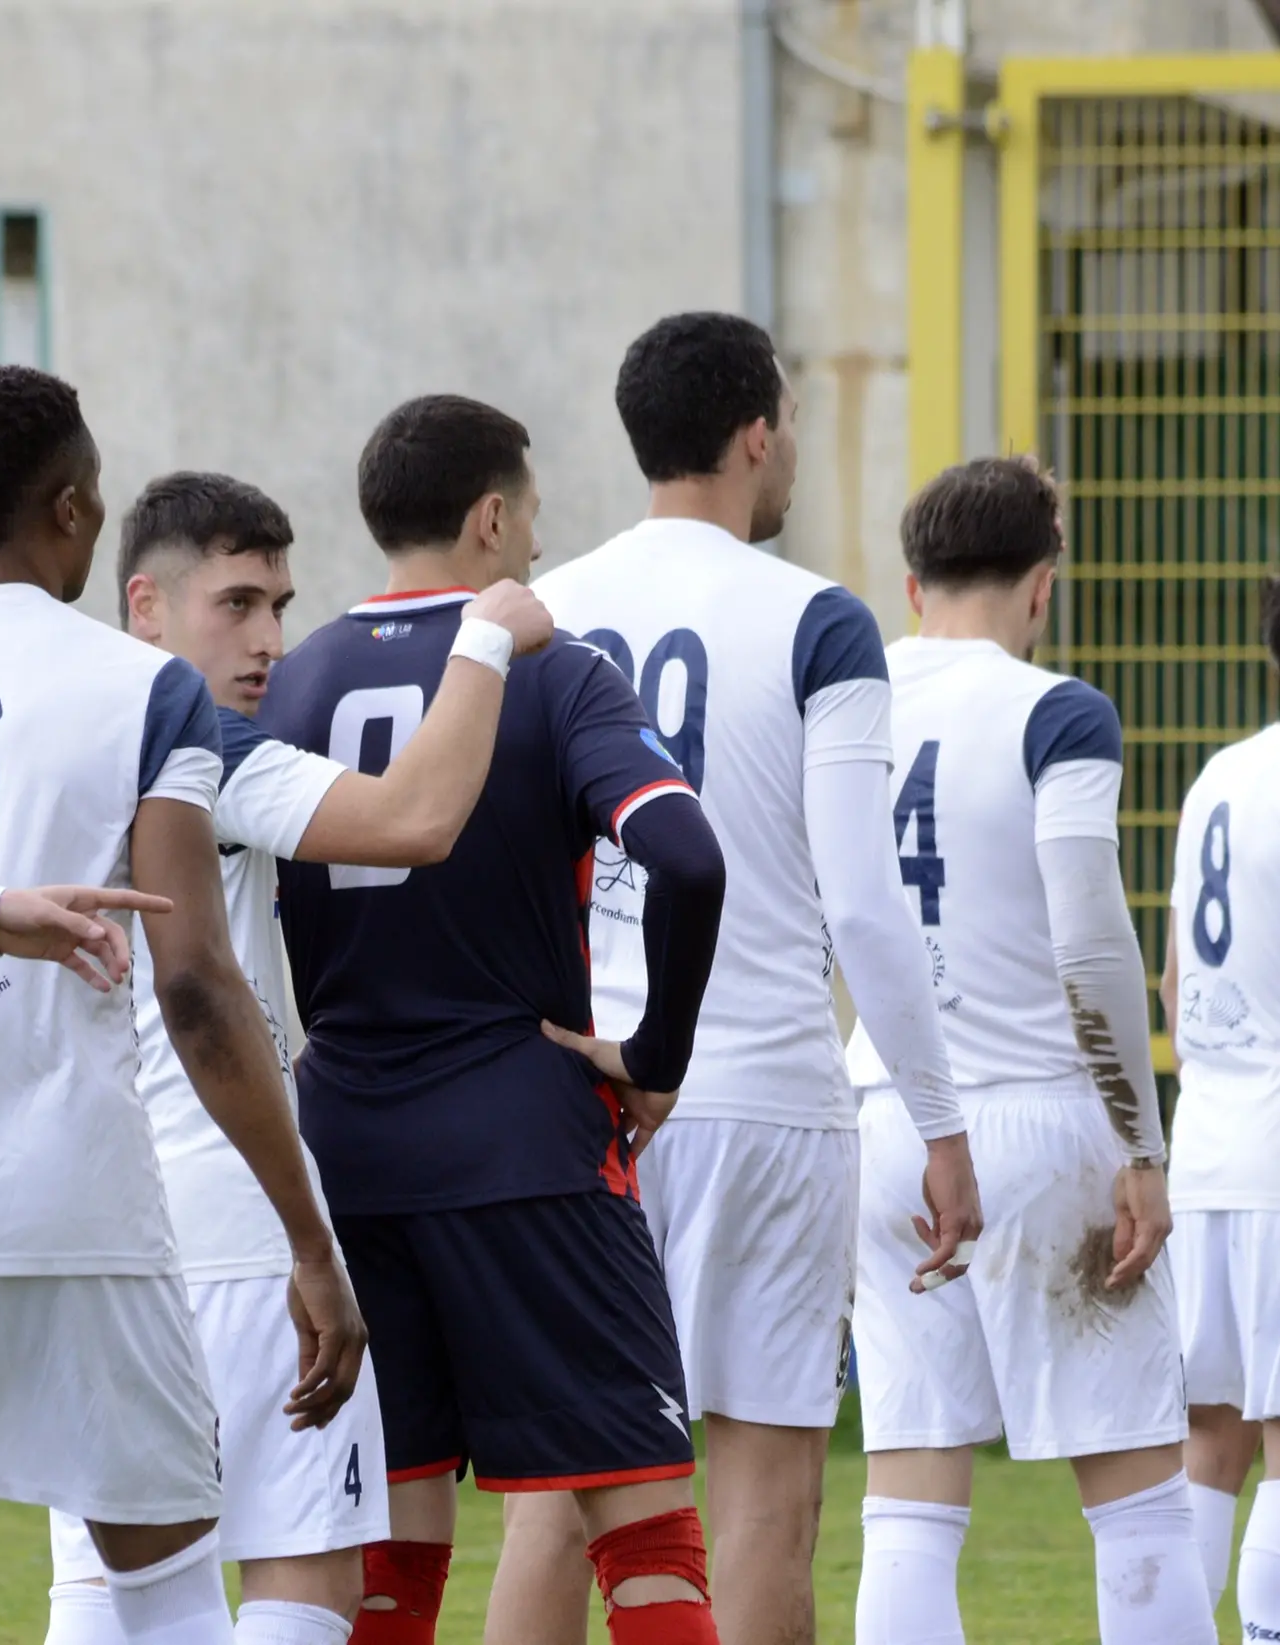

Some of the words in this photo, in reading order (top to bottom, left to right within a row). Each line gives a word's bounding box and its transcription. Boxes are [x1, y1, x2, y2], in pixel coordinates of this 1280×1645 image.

[580, 628, 708, 800] 9
[893, 740, 945, 926] 4
[1193, 801, 1232, 968] 8
[344, 1442, 363, 1508] 4
